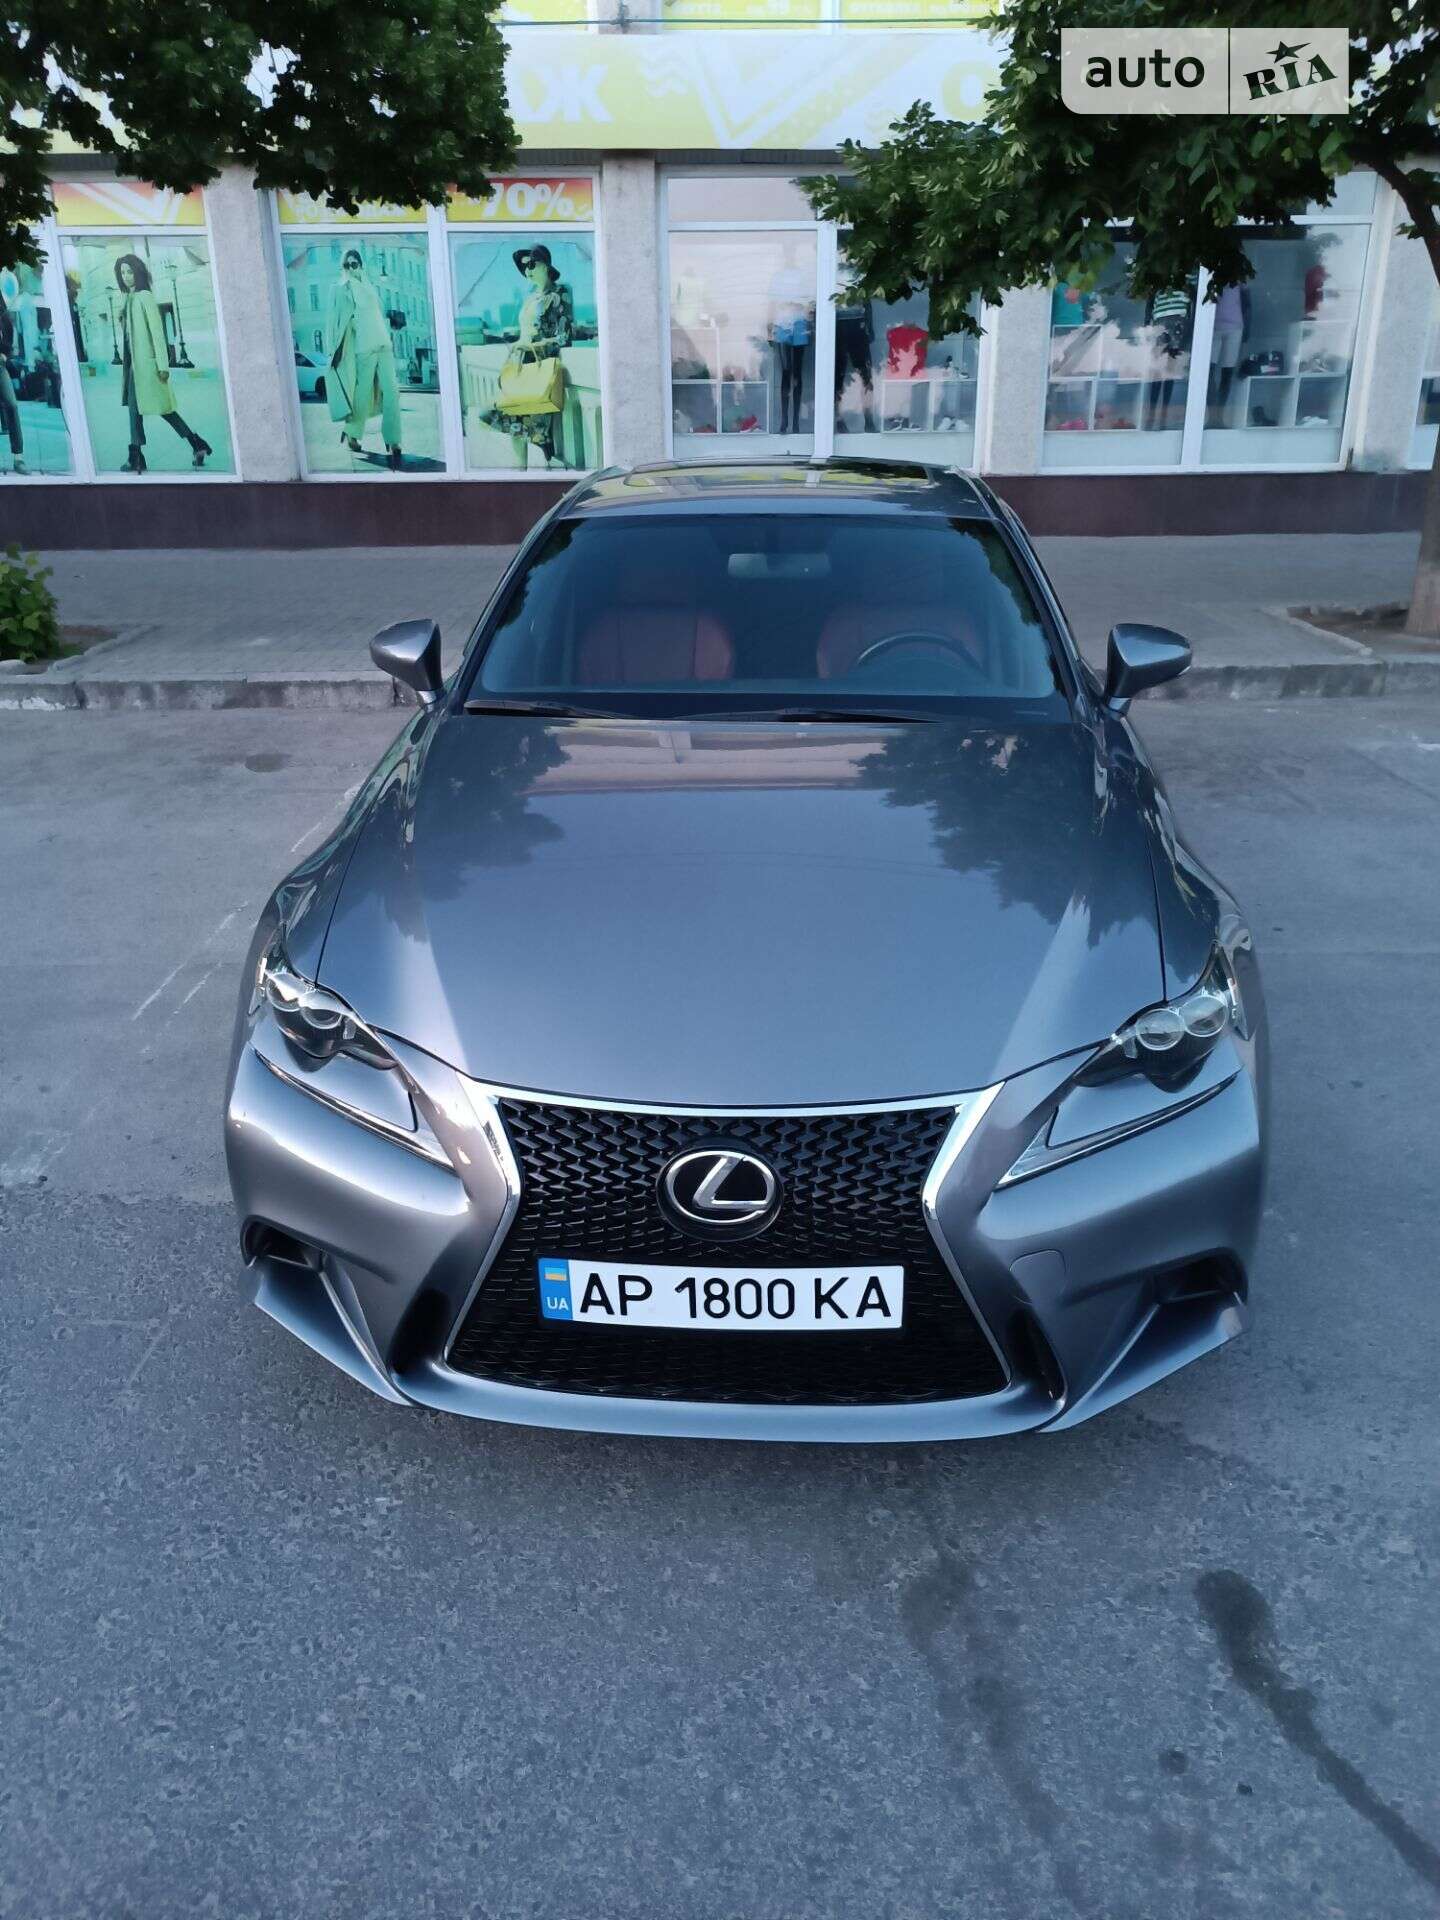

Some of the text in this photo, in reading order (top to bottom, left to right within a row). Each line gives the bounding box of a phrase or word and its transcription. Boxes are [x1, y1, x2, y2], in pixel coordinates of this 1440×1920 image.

[546, 1296, 569, 1311] UA
[579, 1272, 892, 1319] AP 1800 KA
